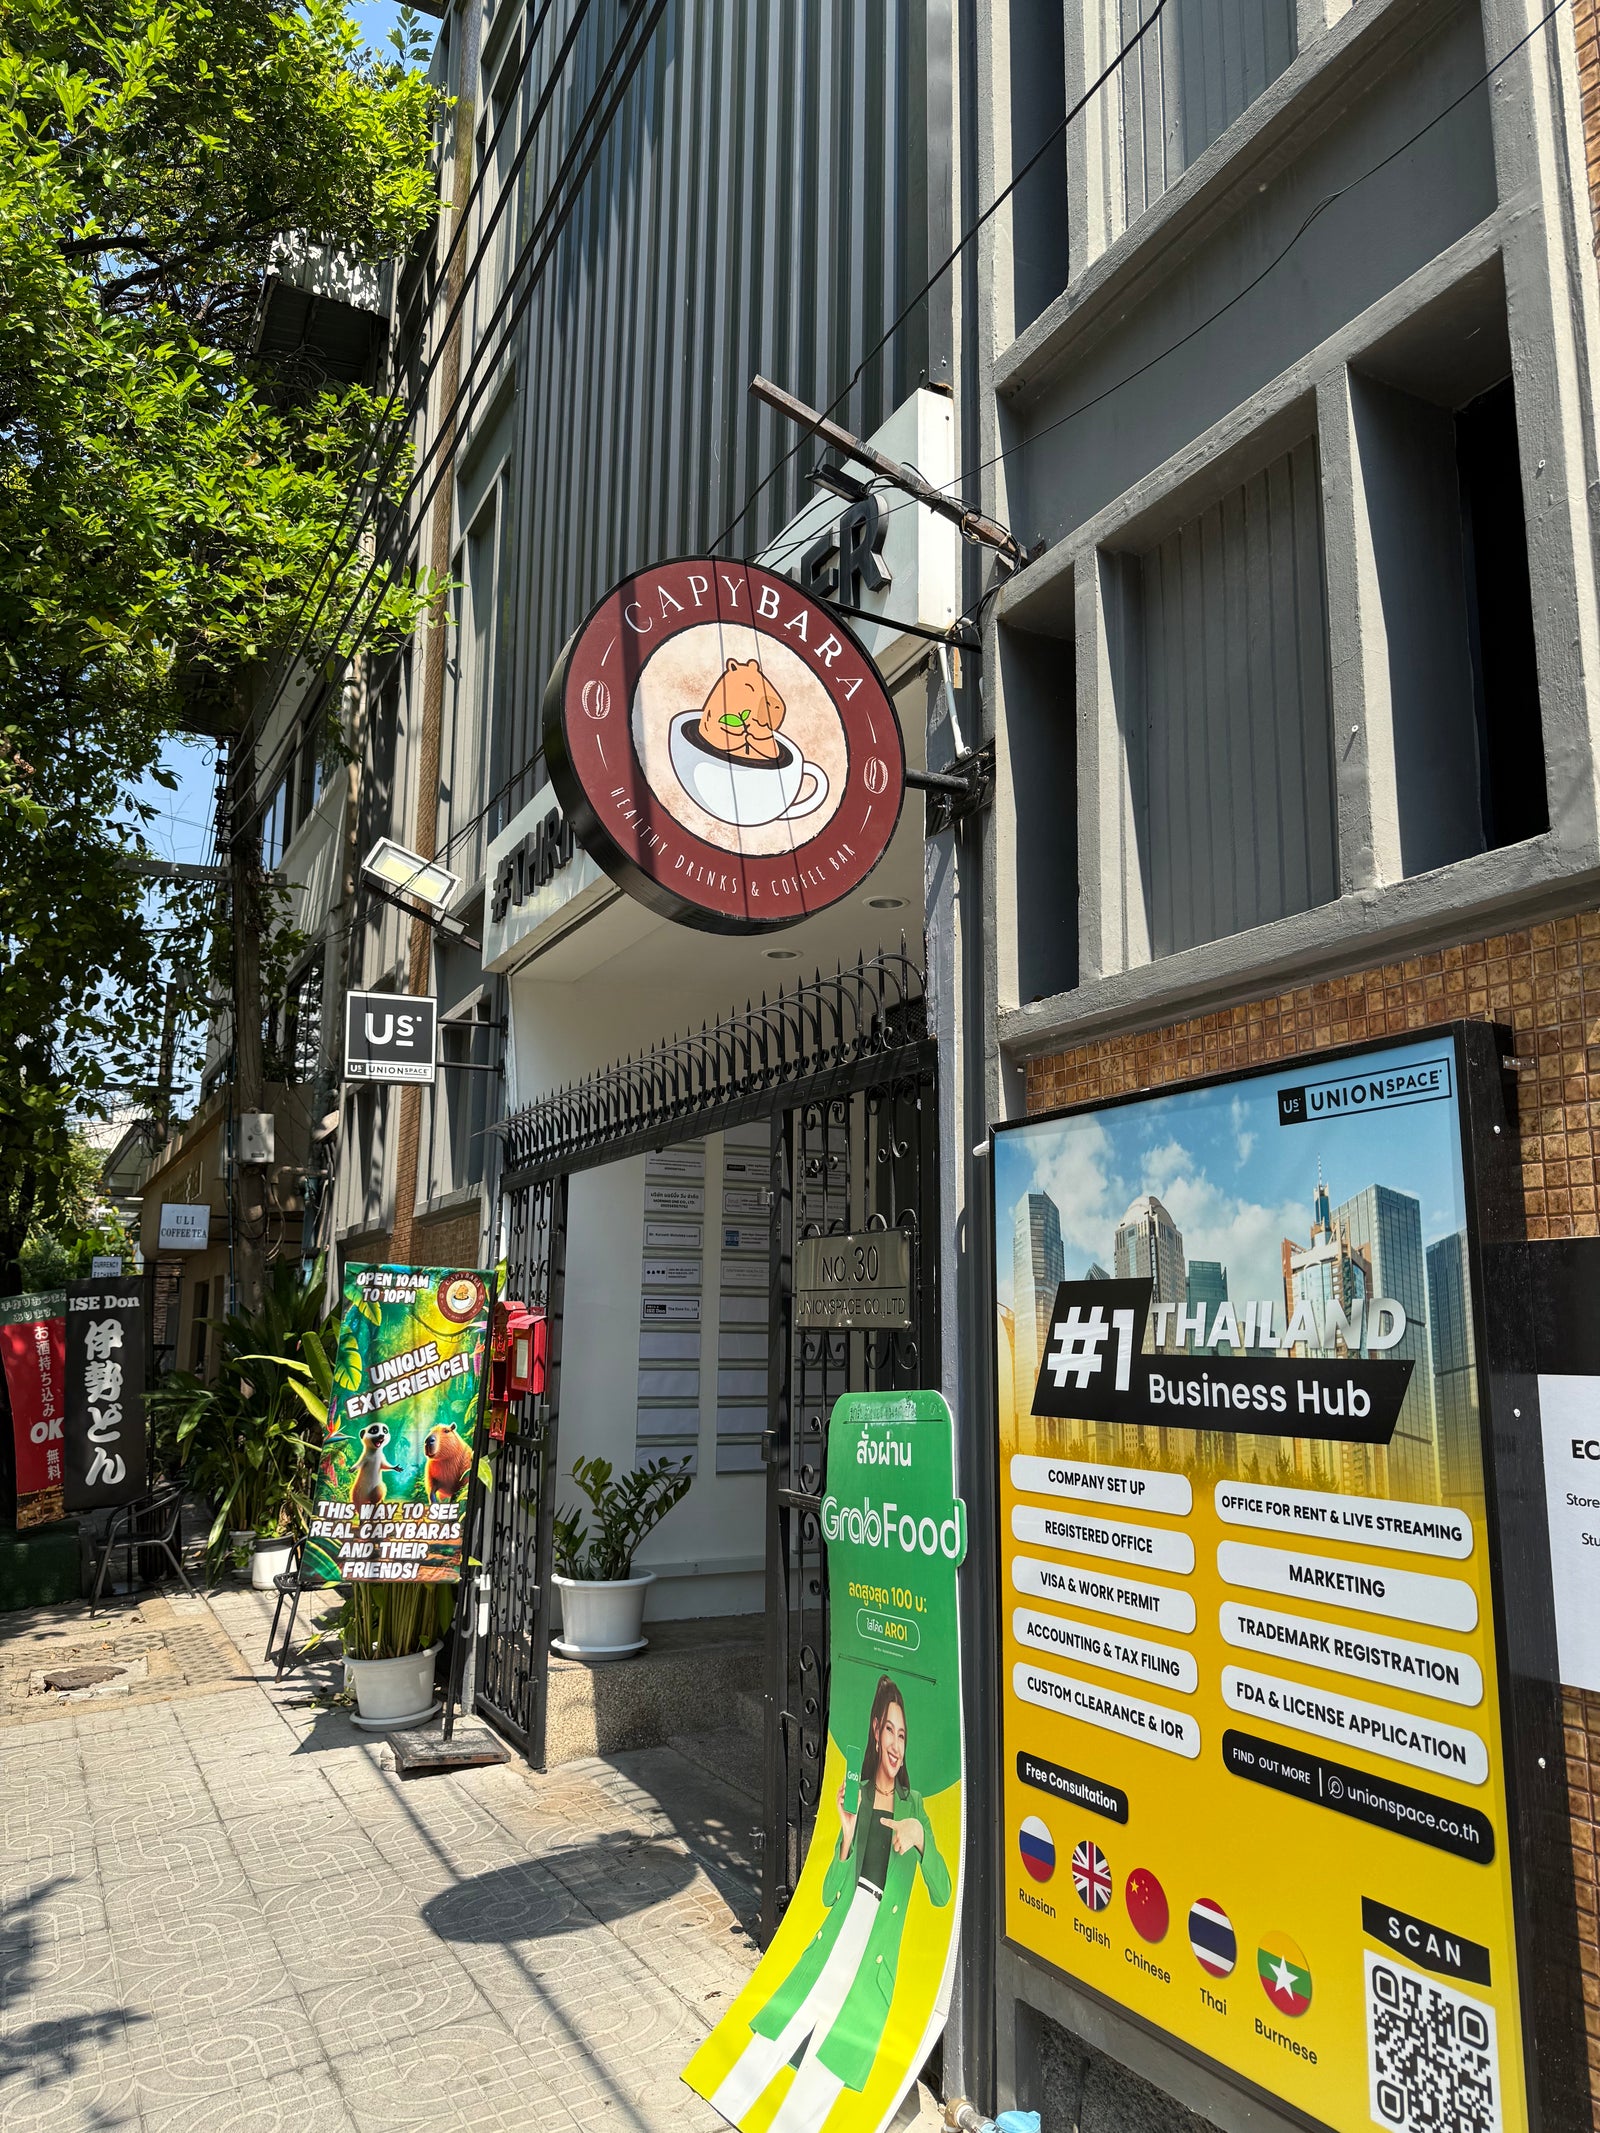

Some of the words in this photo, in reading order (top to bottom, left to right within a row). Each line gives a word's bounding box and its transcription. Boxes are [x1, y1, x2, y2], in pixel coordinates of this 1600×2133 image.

[624, 575, 864, 701] CAPYBARA
[609, 786, 668, 856] HEALTHY
[675, 854, 738, 895] DRINKS
[751, 881, 760, 897] &
[771, 865, 826, 897] COFFEE
[829, 843, 856, 871] BAR
[1310, 1069, 1443, 1111] UNIONSPACE
[161, 1227, 191, 1238] COFFEE
[192, 1228, 207, 1239] TEA
[356, 1272, 391, 1286] OPEN
[395, 1274, 430, 1288] 10AM
[363, 1288, 380, 1302] TO
[383, 1290, 417, 1304] 10PM
[69, 1295, 100, 1311] ISE
[104, 1295, 140, 1309] Don
[1150, 1297, 1407, 1351] THAILAND
[370, 1342, 440, 1385] UNIQUE
[1046, 1305, 1135, 1392] #1
[34, 1325, 55, 1417] お酒持ち込み
[346, 1352, 470, 1419] EXPERIENCE!
[84, 1318, 127, 1486] 伊勢どん
[1149, 1372, 1287, 1413] Business
[1297, 1378, 1371, 1418] Hub
[30, 1416, 65, 1444] OK
[856, 1419, 912, 1467] สั่งผ่าน
[46, 1449, 62, 1481] 無料
[1048, 1469, 1105, 1490] COMPANY
[1107, 1477, 1127, 1493] SET
[1129, 1481, 1145, 1496] UP
[310, 1520, 355, 1538] REAL
[360, 1522, 461, 1540] CAPYBARAS
[318, 1501, 355, 1519] THIS
[360, 1503, 398, 1520] WAY
[403, 1503, 424, 1519] TO
[429, 1503, 460, 1520] SEE
[821, 1495, 961, 1559] GrabFood
[1221, 1495, 1263, 1513] OFFICE
[1266, 1501, 1290, 1517] FOR
[1294, 1506, 1327, 1523] RENT
[1330, 1510, 1339, 1524] &
[1343, 1512, 1373, 1529] LIVE
[1376, 1516, 1462, 1542] STREAMING
[338, 1542, 375, 1558] AND
[379, 1542, 429, 1559] THEIR
[1045, 1520, 1109, 1545] REGISTERED
[1111, 1532, 1153, 1554] OFFICE
[342, 1561, 420, 1579] FRIENDS!
[1289, 1564, 1386, 1598] MARKETING
[848, 1581, 890, 1610] ลดสูงสุด
[891, 1586, 913, 1610] 100
[1040, 1571, 1066, 1590] VISA
[1068, 1578, 1077, 1592] &
[1078, 1580, 1114, 1602] WORK
[1117, 1589, 1160, 1612] PERMIT
[884, 1621, 908, 1642] AROI
[1027, 1621, 1101, 1654] ACCOUNTING
[1103, 1642, 1112, 1658] &
[1114, 1645, 1139, 1666] TAX
[1141, 1653, 1180, 1677] FILING
[1238, 1616, 1330, 1654] TRADEMARK
[1334, 1638, 1460, 1686] REGISTRATION
[1027, 1676, 1072, 1703] CUSTOM
[1074, 1691, 1146, 1728] CLEARANCE
[1148, 1715, 1158, 1731] &
[1160, 1719, 1185, 1741] IOR
[1236, 1681, 1265, 1705] FDA
[1268, 1690, 1280, 1709] &
[1283, 1694, 1345, 1729] LICENSE
[1348, 1713, 1467, 1766] APPLICATION
[1025, 1761, 1048, 1783] Free
[1049, 1772, 1119, 1813] Consultation
[1233, 1747, 1255, 1765] FIND
[1258, 1756, 1279, 1774] OUT
[1281, 1764, 1311, 1785] MORE
[1347, 1782, 1480, 1844] unionspace.co.th
[1018, 1886, 1056, 1919] Russian
[1073, 1916, 1111, 1950] English
[1387, 1915, 1462, 1968] SCAN
[1124, 1947, 1171, 1984] Chinese
[1199, 1986, 1228, 2017] Thai
[1254, 2017, 1318, 2065] Burmese
